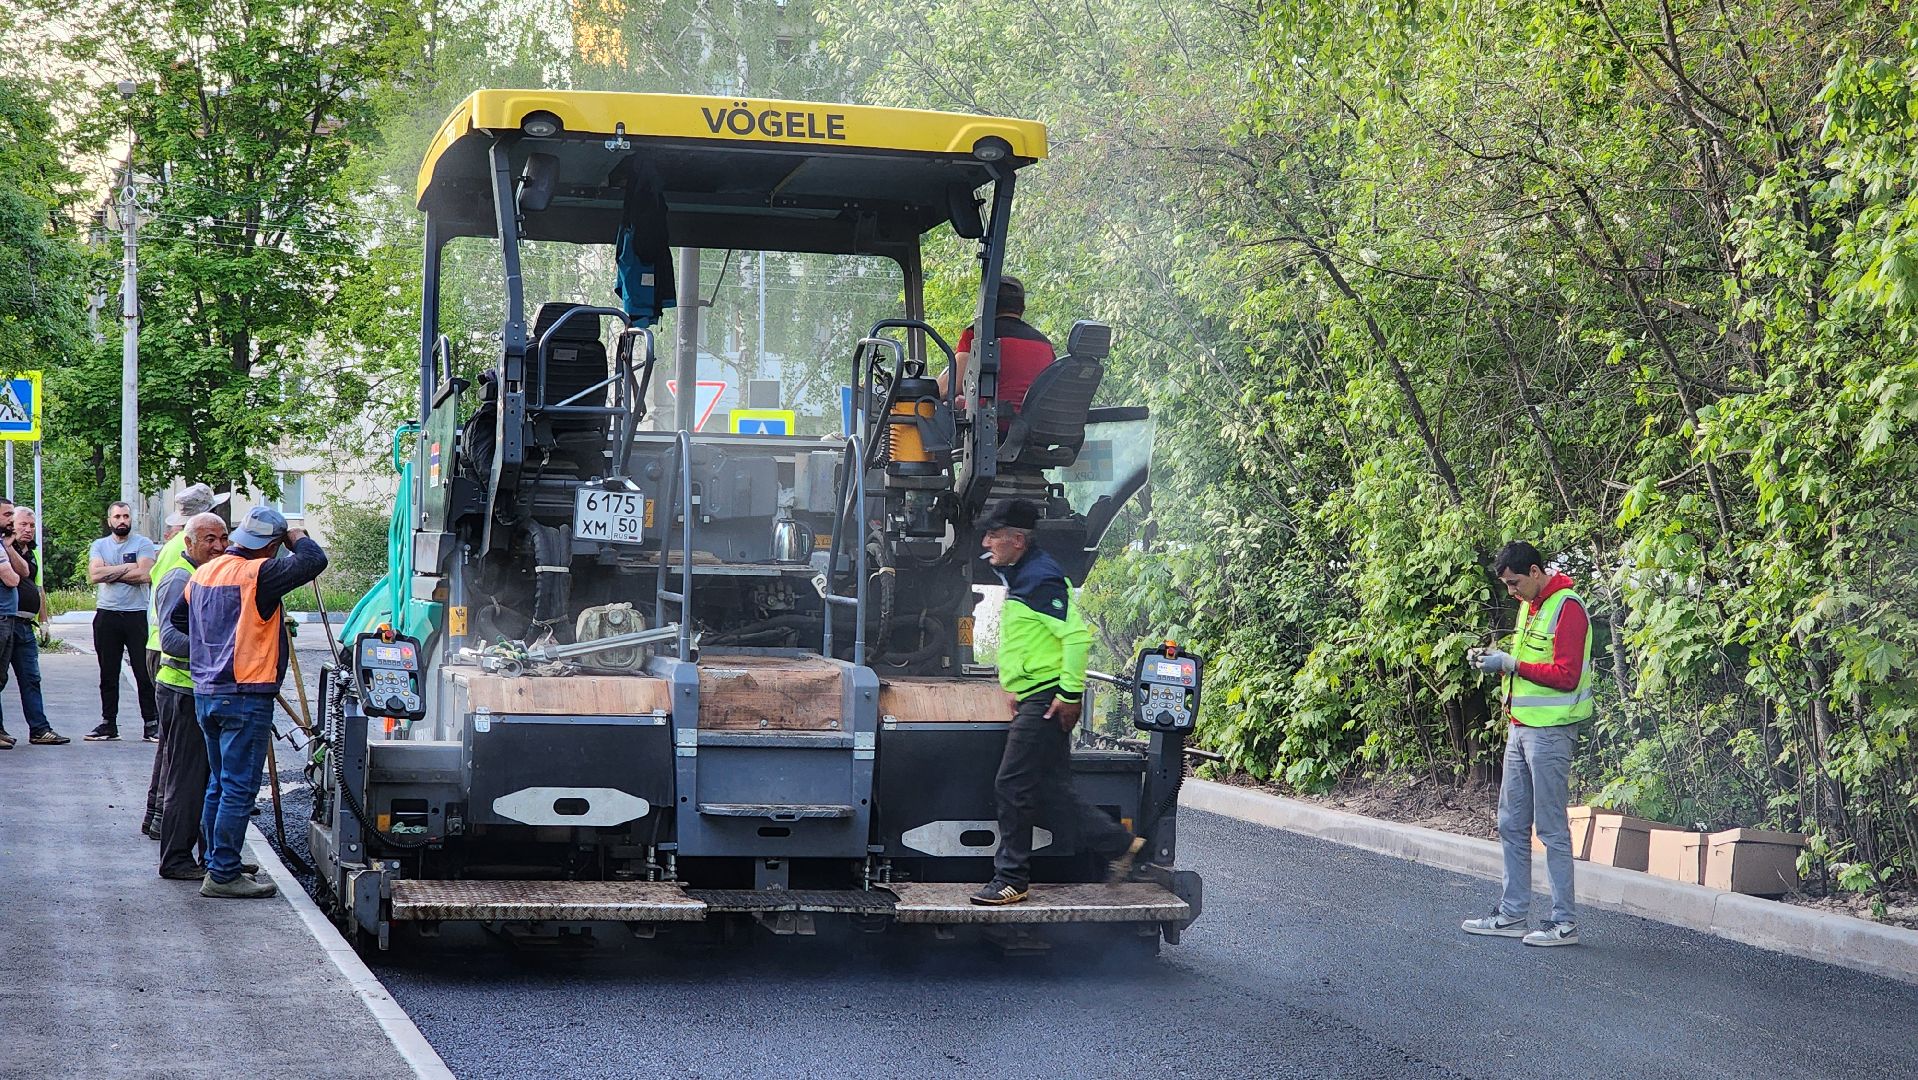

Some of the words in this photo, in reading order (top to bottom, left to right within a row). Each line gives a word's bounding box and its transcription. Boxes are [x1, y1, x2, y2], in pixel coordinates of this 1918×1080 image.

[701, 102, 846, 140] VÖGELE
[587, 493, 635, 514] 6175
[619, 518, 637, 533] 50
